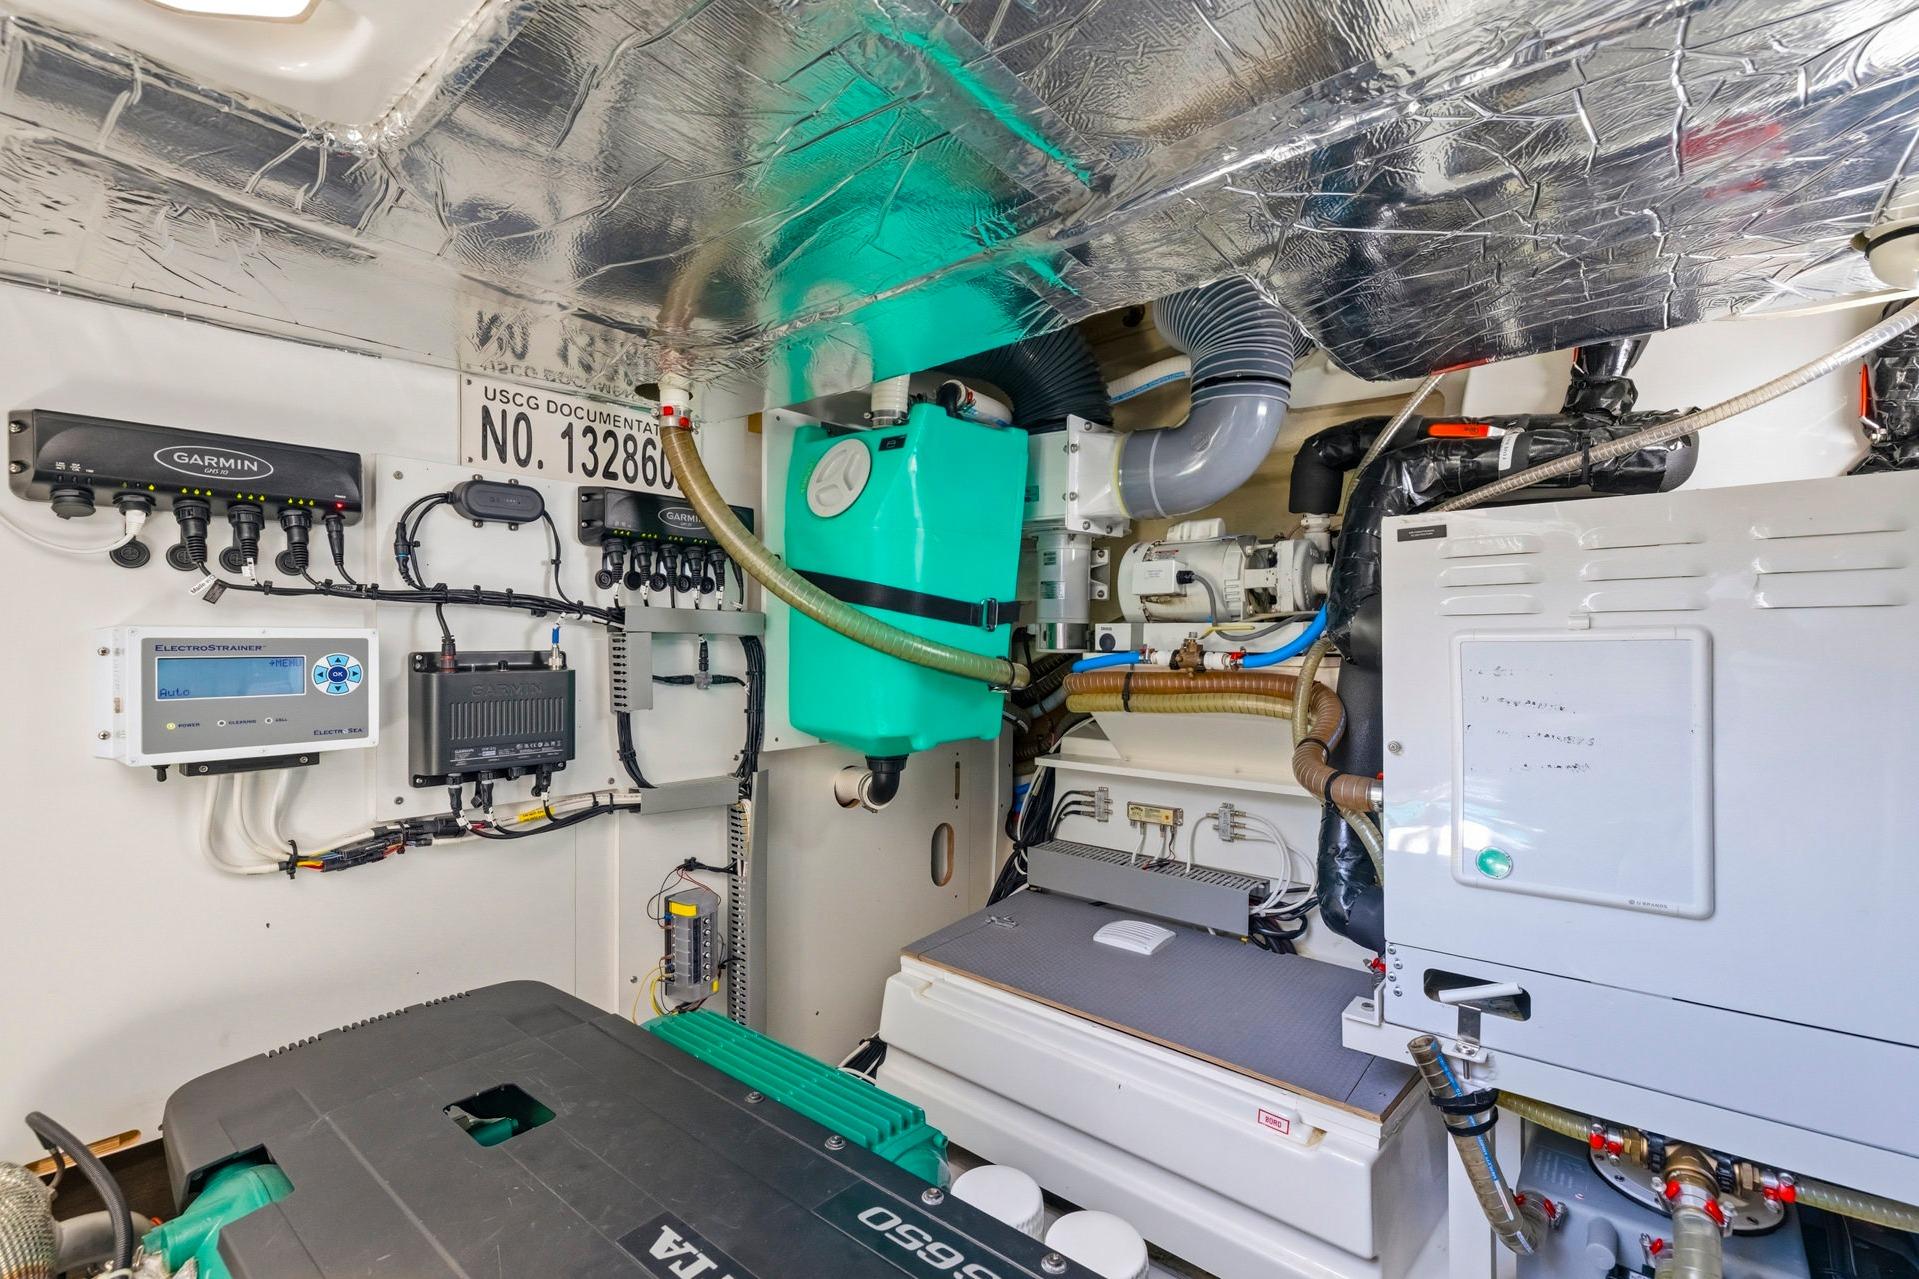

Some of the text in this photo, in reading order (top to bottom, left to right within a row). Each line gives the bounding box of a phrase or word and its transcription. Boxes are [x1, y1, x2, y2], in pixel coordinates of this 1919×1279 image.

[484, 386, 540, 410] USCG
[481, 404, 681, 492] NO. 132860
[173, 452, 258, 472] GARMIN
[666, 511, 701, 523] GARMI
[275, 658, 302, 668] MENU
[159, 687, 190, 697] Auto
[472, 681, 543, 697] GARMIN
[649, 1224, 734, 1279] TA
